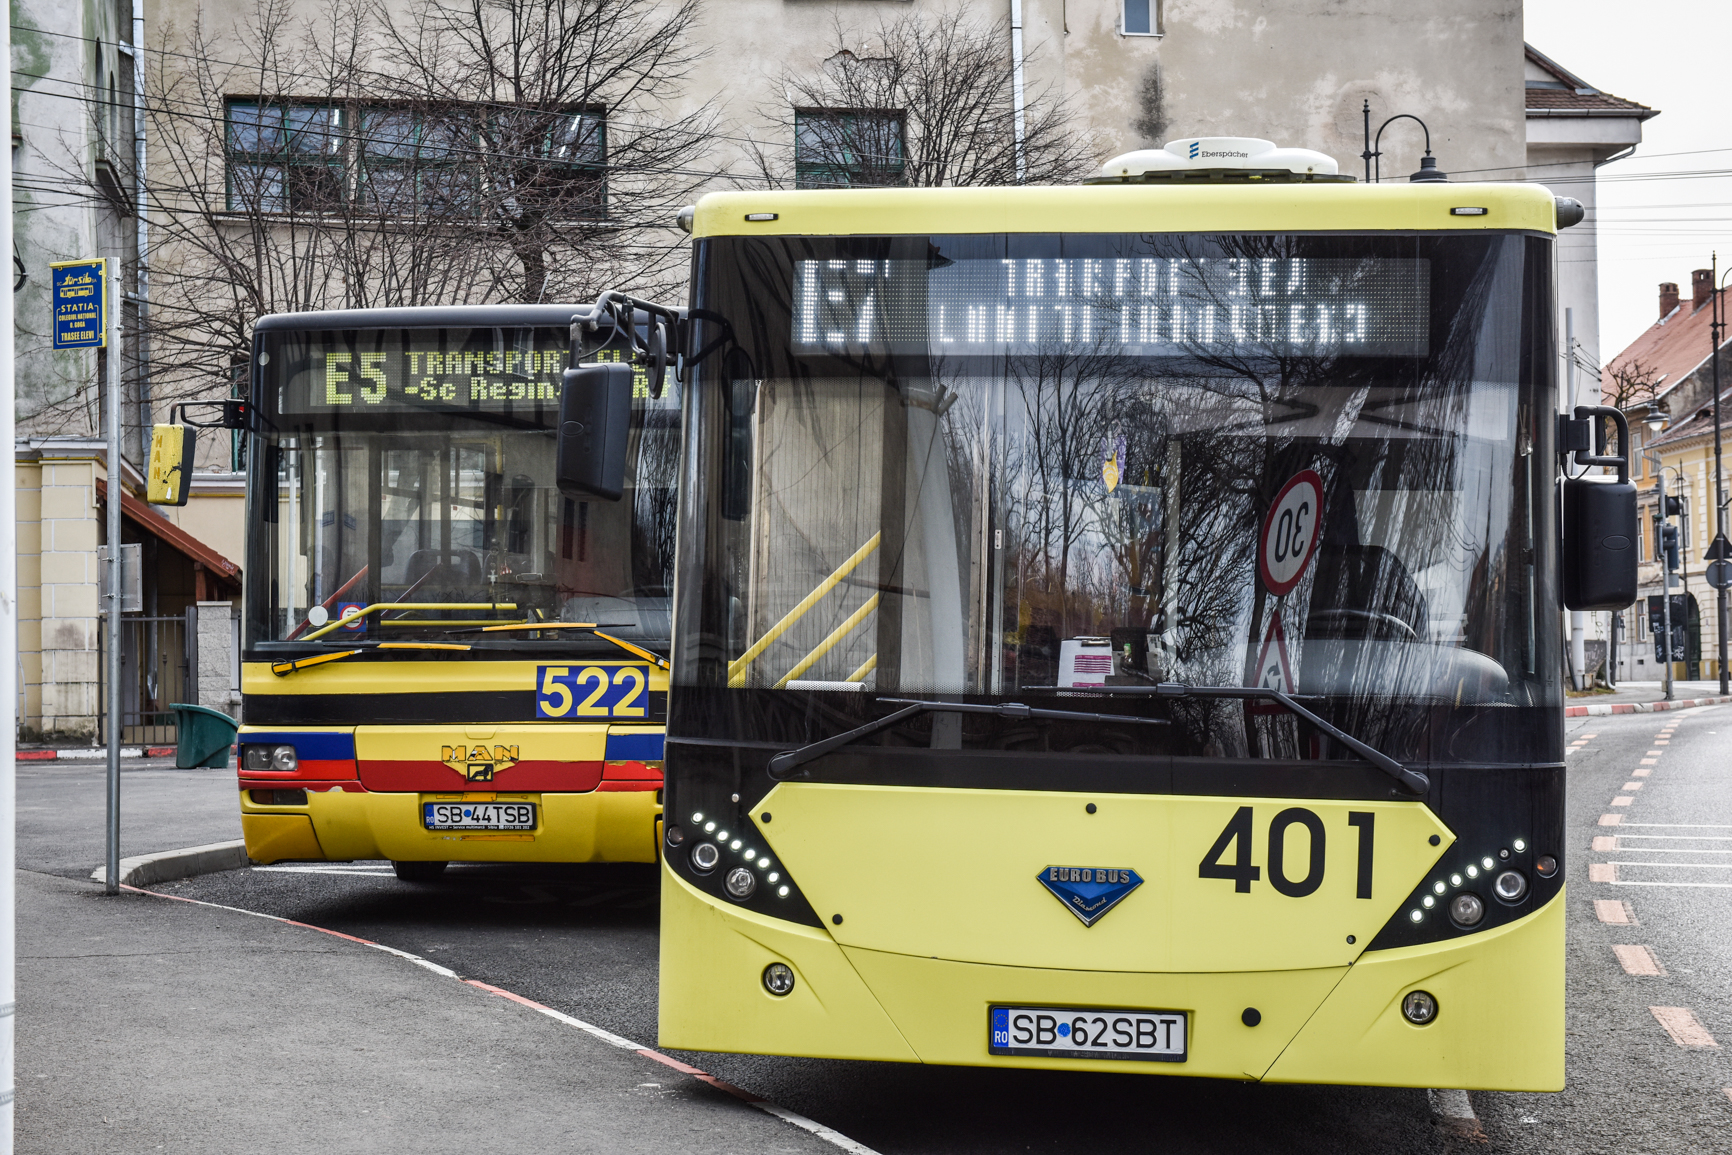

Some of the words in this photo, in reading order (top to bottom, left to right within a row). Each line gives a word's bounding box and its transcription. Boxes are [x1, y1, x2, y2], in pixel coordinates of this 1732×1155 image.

[61, 332, 81, 341] TRASEE
[81, 330, 95, 339] ELEVI
[325, 352, 388, 404] E5
[539, 666, 645, 718] 522
[441, 745, 520, 762] MAN
[426, 816, 434, 824] RO
[437, 806, 463, 824] SB
[471, 806, 530, 824] 44TSB
[1198, 806, 1375, 899] 401
[1050, 868, 1092, 882] EURO
[1096, 869, 1130, 883] BUS
[995, 1031, 1008, 1043] RO
[1013, 1014, 1057, 1045] SB
[1071, 1016, 1177, 1049] 62SBT
